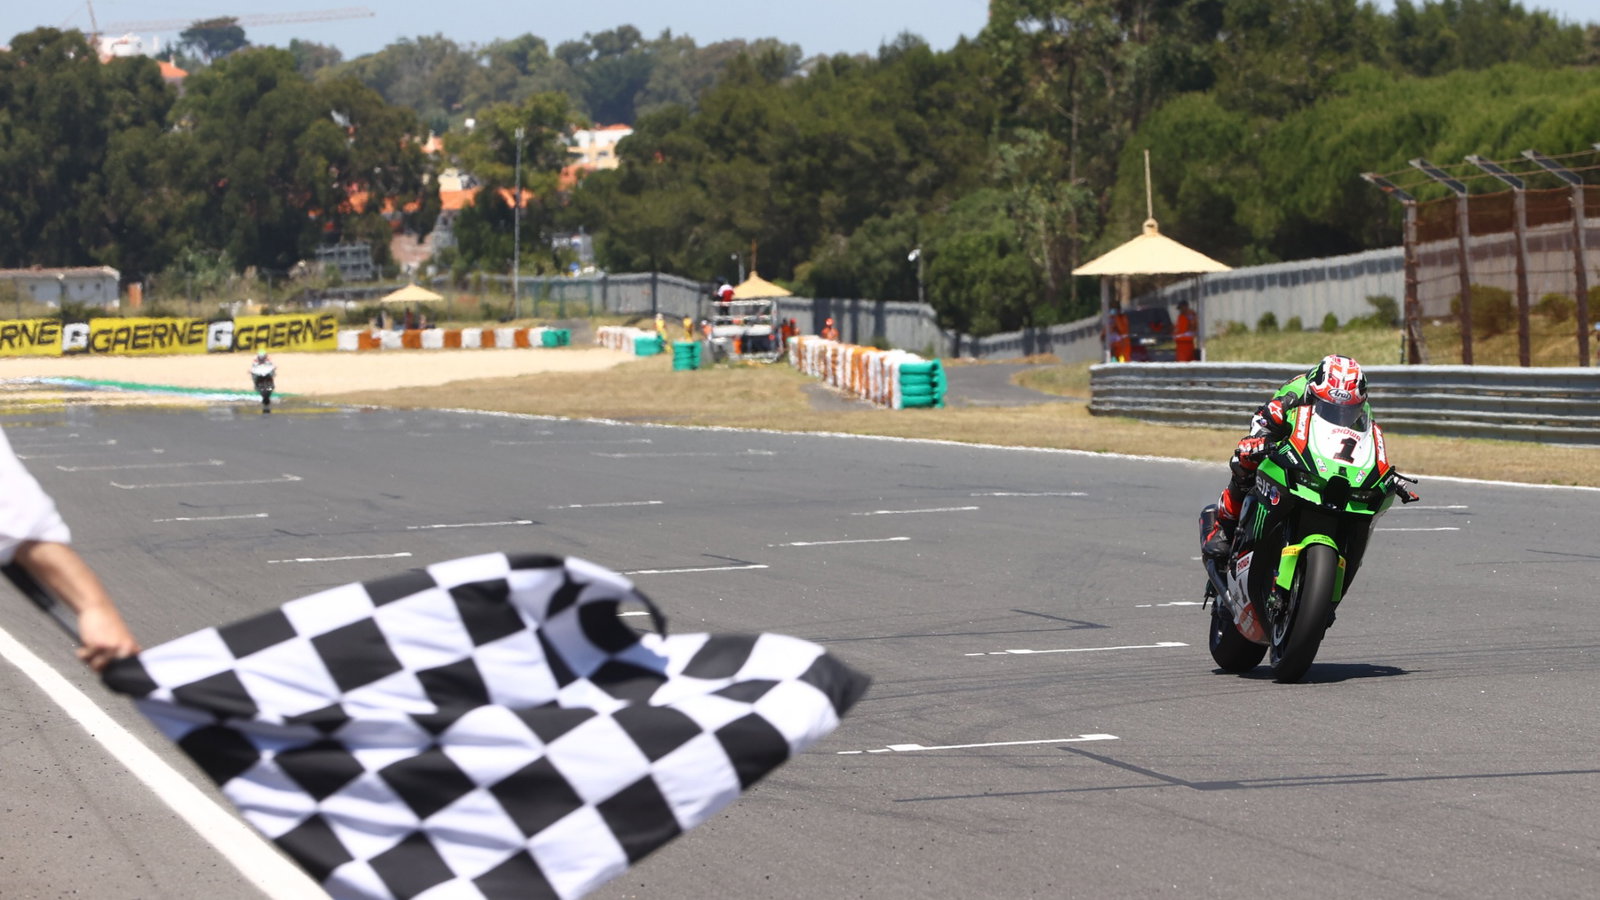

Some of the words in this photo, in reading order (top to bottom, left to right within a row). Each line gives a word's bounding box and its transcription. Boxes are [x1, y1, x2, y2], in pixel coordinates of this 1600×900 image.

[92, 321, 205, 353] GAERNE
[236, 315, 334, 351] GAERNE
[1333, 390, 1349, 399] Arai
[1331, 427, 1361, 442] SHOWA
[1333, 437, 1357, 464] 1
